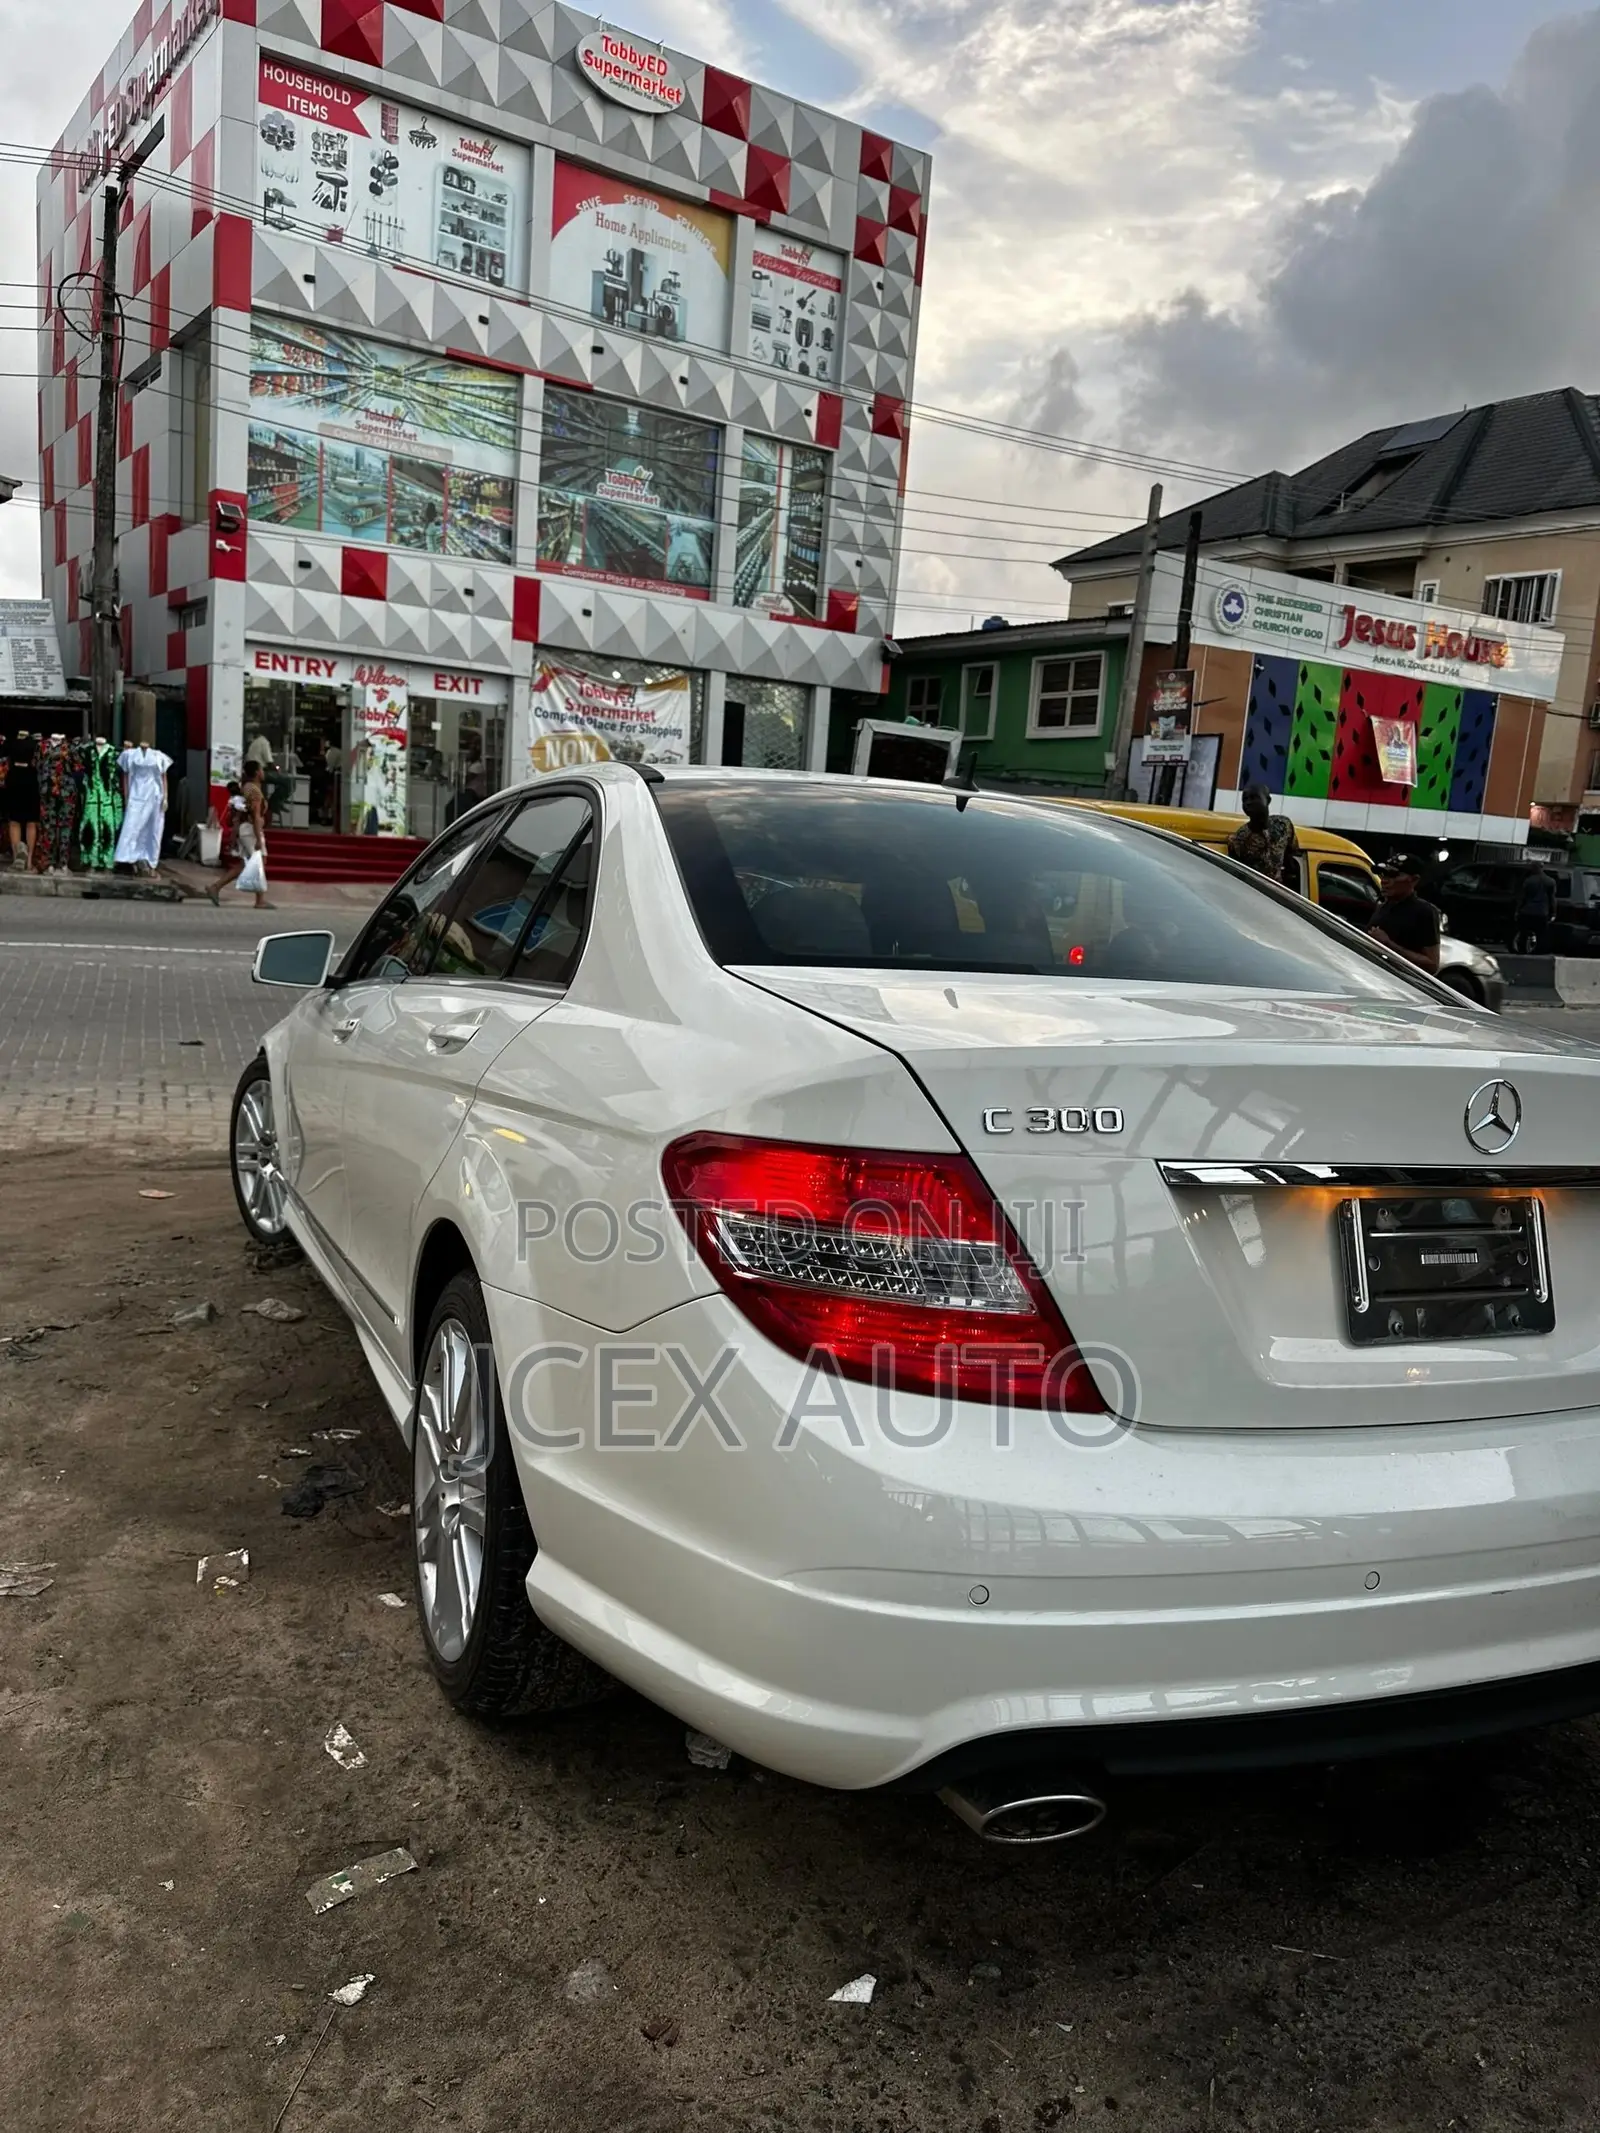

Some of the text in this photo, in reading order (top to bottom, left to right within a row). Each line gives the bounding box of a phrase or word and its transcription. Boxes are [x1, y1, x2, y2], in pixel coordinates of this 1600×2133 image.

[602, 34, 667, 76] TobbyED
[263, 63, 351, 105] HOUSEHOLD
[583, 48, 682, 104] Supermarket
[287, 94, 328, 120] ITEMS
[452, 148, 504, 173] Supermarket
[575, 195, 602, 212] SAVE
[623, 194, 659, 212] SPEND
[595, 211, 688, 254] Home Appliances
[354, 419, 418, 441] Supermarket
[598, 484, 659, 506] Supermarket
[1254, 606, 1303, 623] CHRISTIAN
[1256, 592, 1323, 613] THE REDEEMED
[1252, 620, 1323, 639] CHURCH OF GOD
[1335, 604, 1511, 669] Jesus House
[255, 650, 337, 678] ENTRY
[433, 671, 484, 696] EXIT
[620, 721, 637, 734] For
[639, 723, 683, 740] Shopping
[545, 738, 598, 769] NOW
[983, 1105, 1125, 1134] C 300
